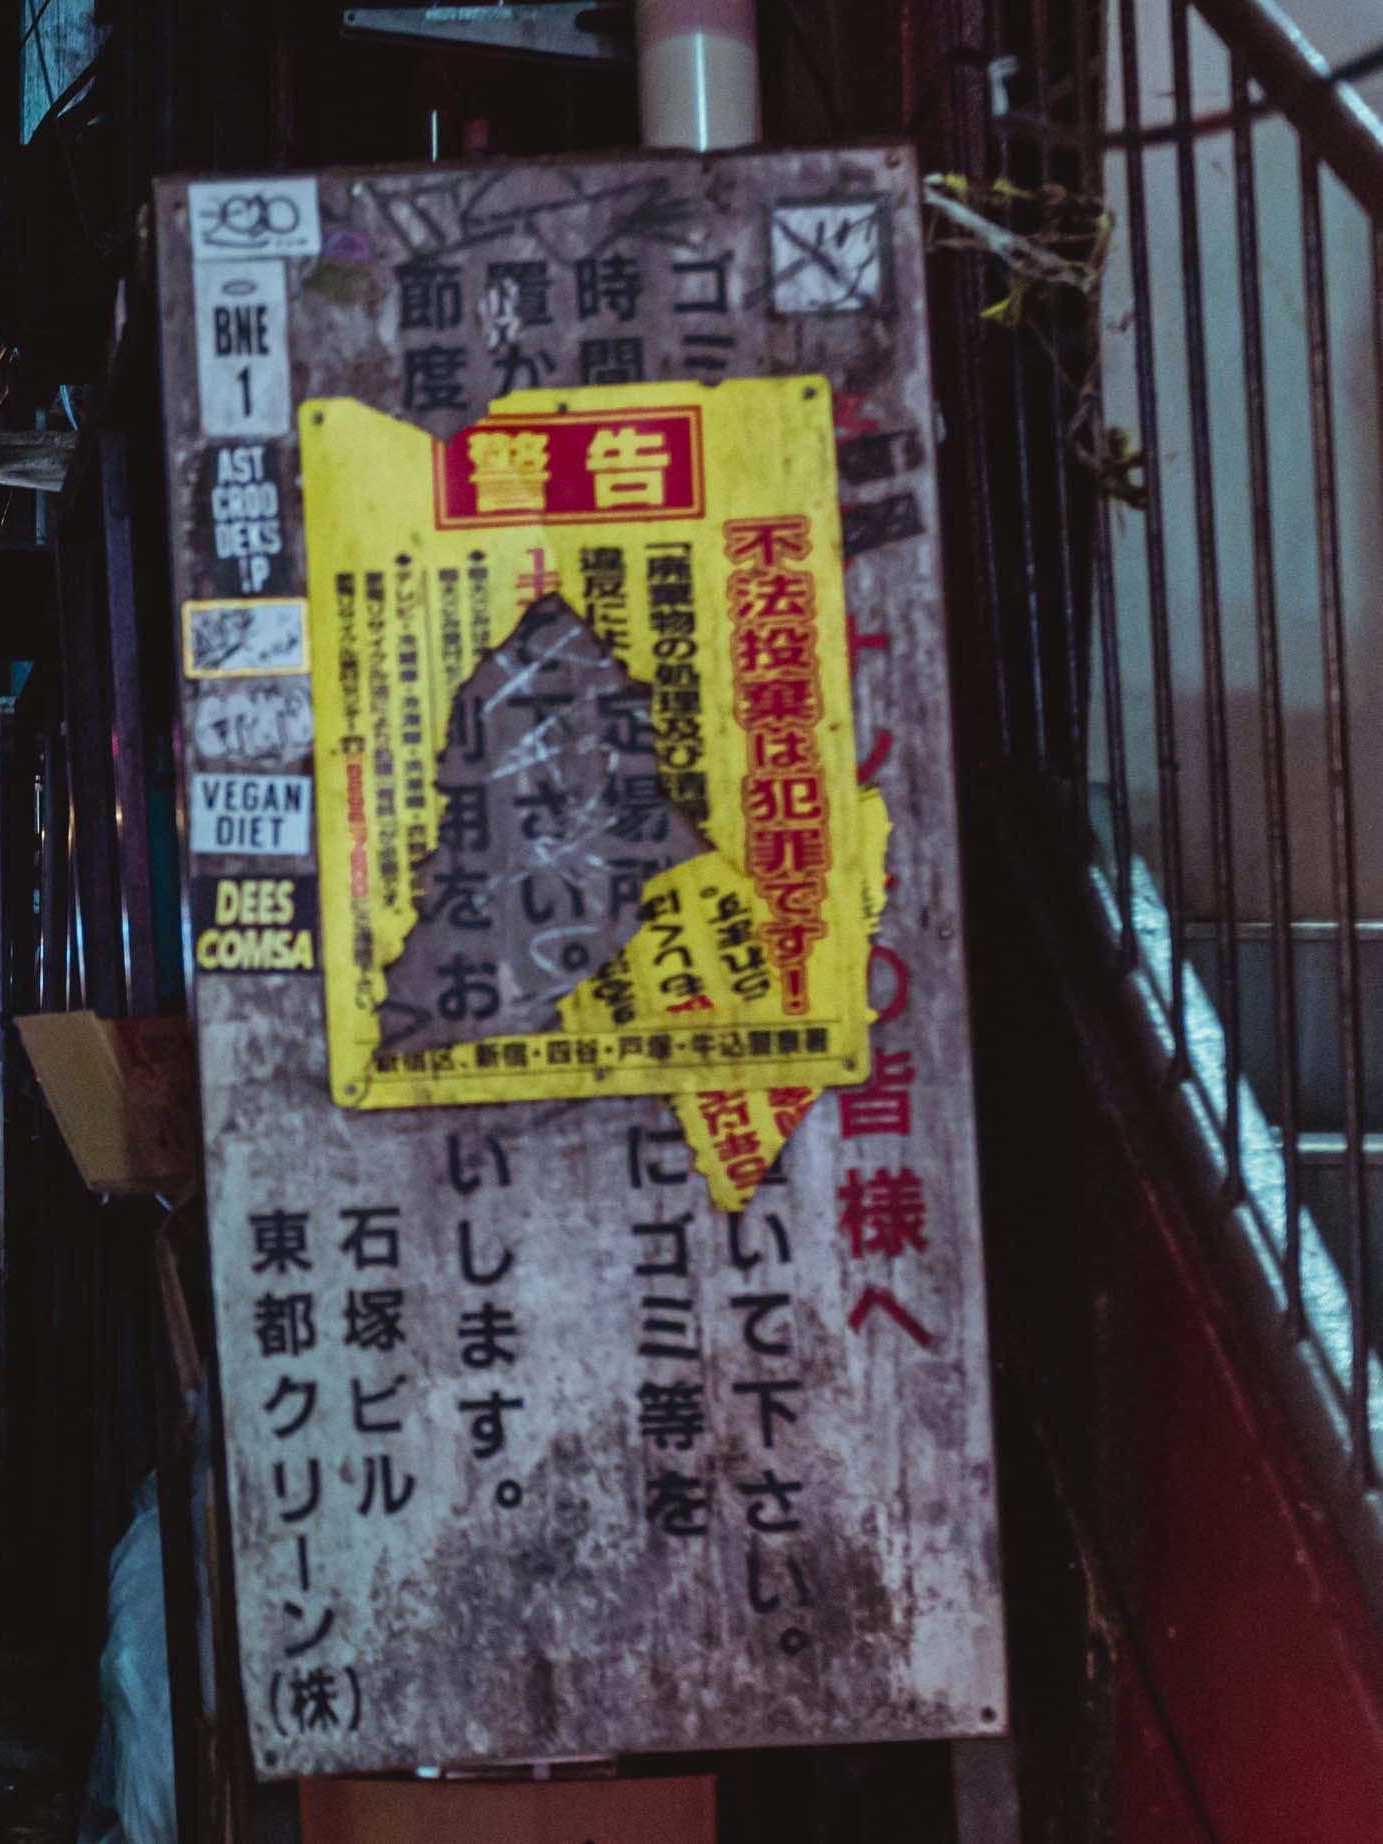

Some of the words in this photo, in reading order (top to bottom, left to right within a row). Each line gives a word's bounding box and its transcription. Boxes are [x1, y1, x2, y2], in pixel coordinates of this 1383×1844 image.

[214, 305, 270, 356] BNE
[236, 365, 252, 418] 1
[467, 426, 671, 514] 警告
[725, 518, 829, 1012] 不法投棄は犯罪です!
[202, 779, 303, 813] VEGAN
[216, 815, 283, 847] DIET
[215, 879, 297, 926] DEES
[397, 262, 469, 414] 節度
[447, 1134, 523, 1512] いします。
[196, 928, 315, 970] COMSA
[339, 1204, 415, 1518] 石塚ビル
[249, 1208, 363, 1738] 東都クリーン(株)
